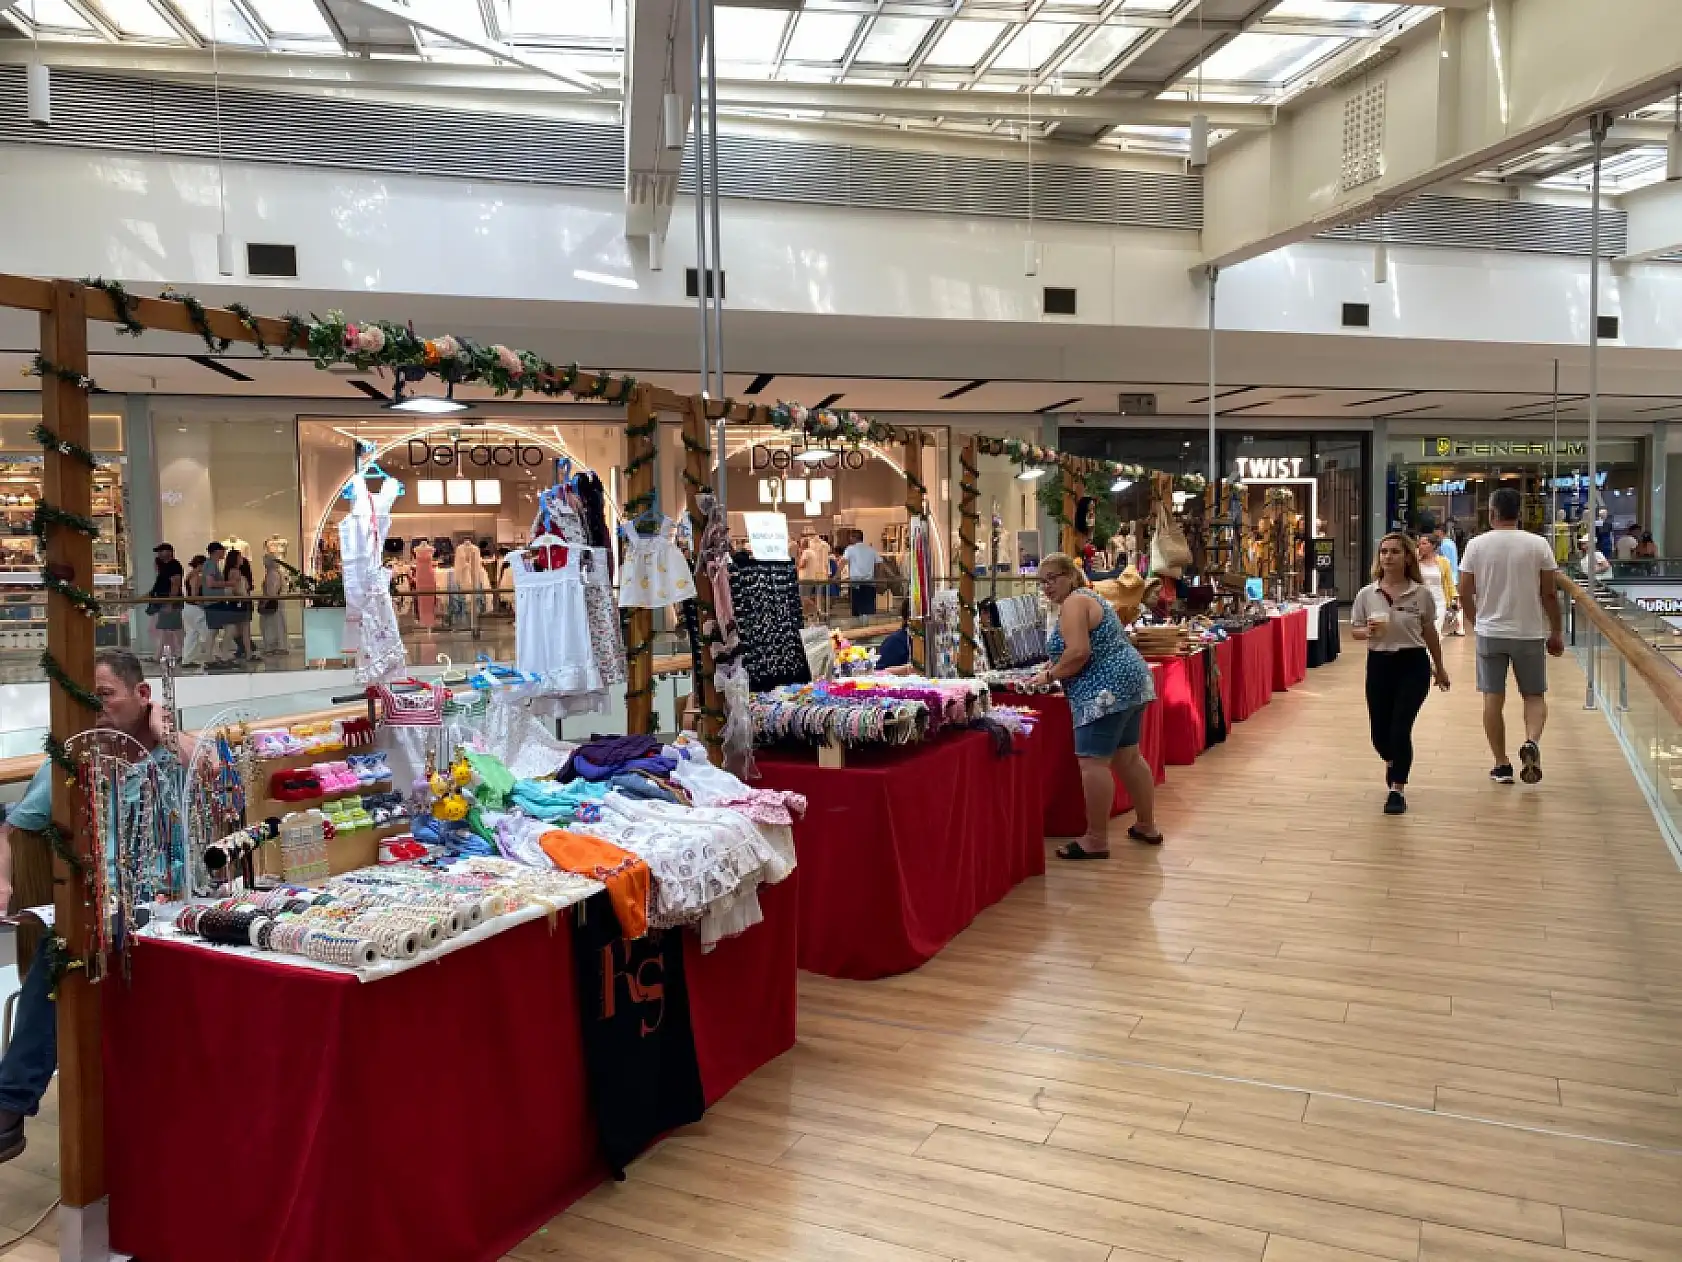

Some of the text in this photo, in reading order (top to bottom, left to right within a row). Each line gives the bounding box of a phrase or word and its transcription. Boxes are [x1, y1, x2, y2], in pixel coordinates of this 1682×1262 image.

[408, 439, 544, 467] DeFacto
[1453, 440, 1585, 457] FENERIUM
[1235, 457, 1304, 479] TWIST
[1316, 554, 1333, 567] 50
